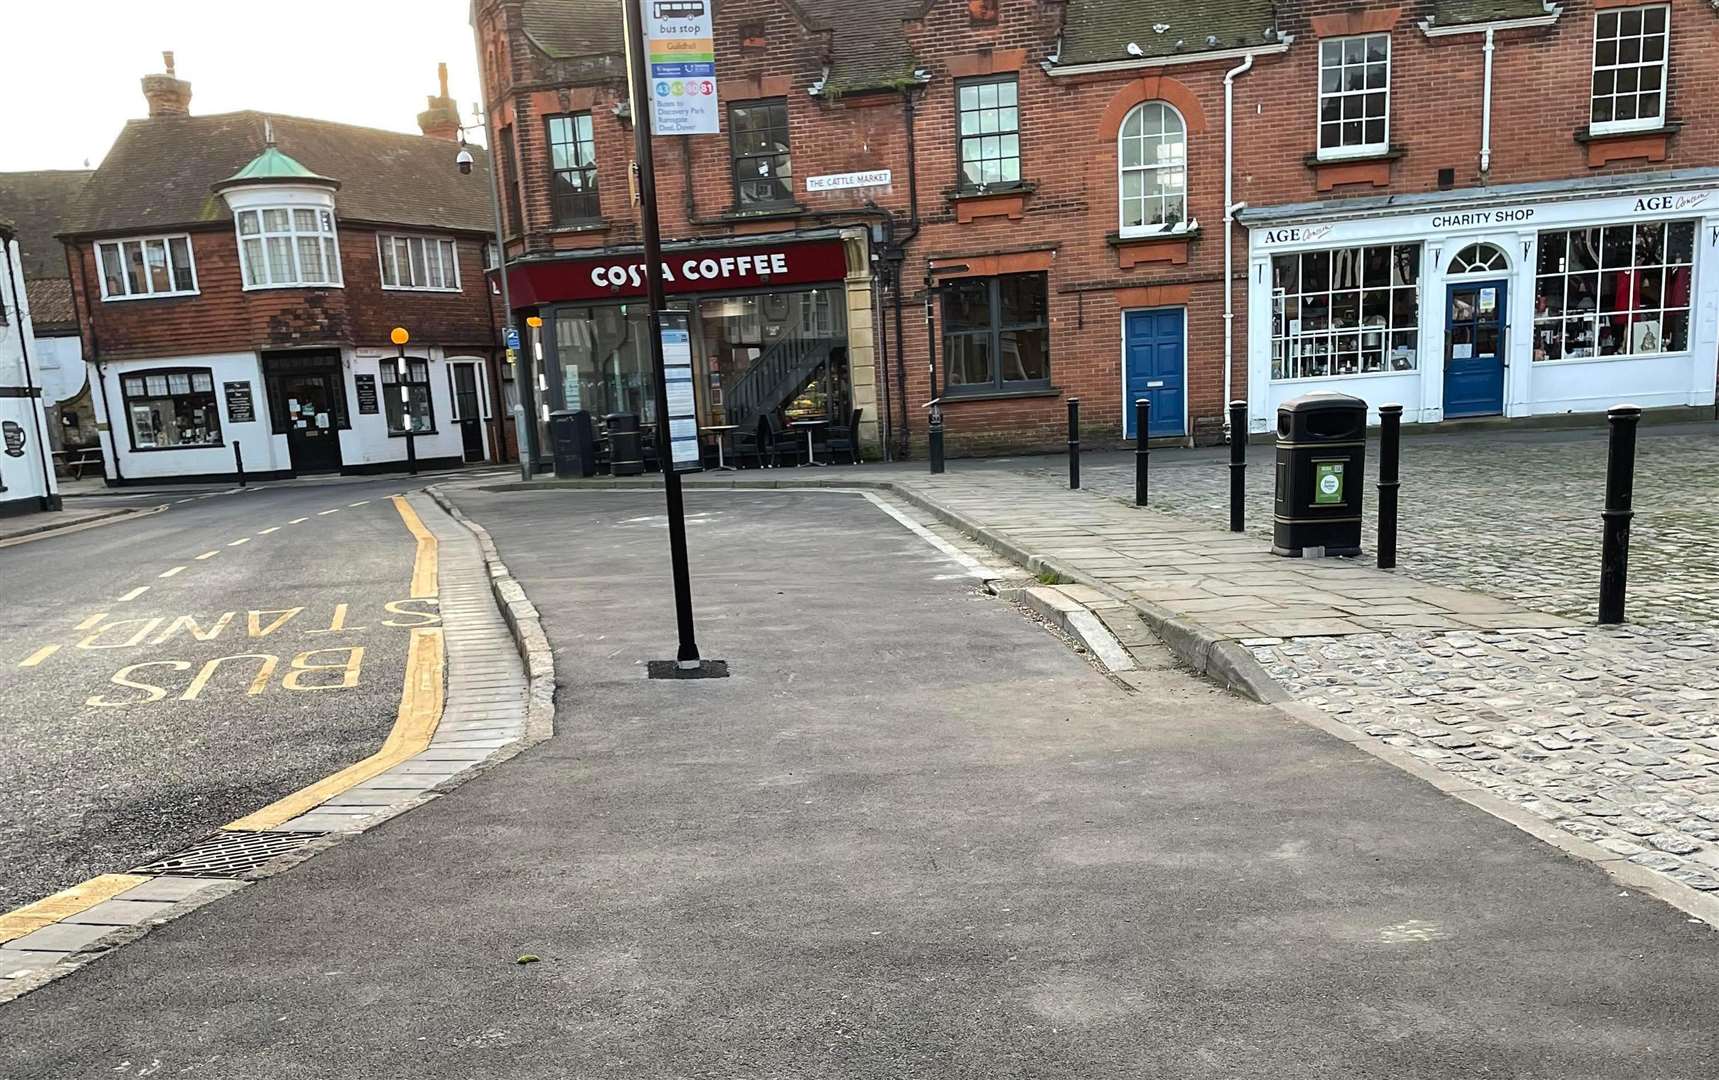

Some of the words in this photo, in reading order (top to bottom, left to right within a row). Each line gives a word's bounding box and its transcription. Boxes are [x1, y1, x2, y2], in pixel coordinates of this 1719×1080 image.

[660, 24, 676, 33] bus
[680, 24, 700, 35] stop
[700, 83, 713, 93] 81
[658, 108, 689, 116] Discovery
[809, 180, 824, 188] THE
[827, 176, 854, 186] CATTLE
[857, 173, 889, 184] MARKET
[1634, 196, 1673, 211] AGE
[1432, 212, 1491, 228] CHARITY
[1495, 209, 1535, 222] SHOP
[1264, 228, 1300, 243] AGE
[682, 253, 788, 280] COFFEE
[75, 598, 443, 650] STAND
[85, 646, 366, 707] BUS
